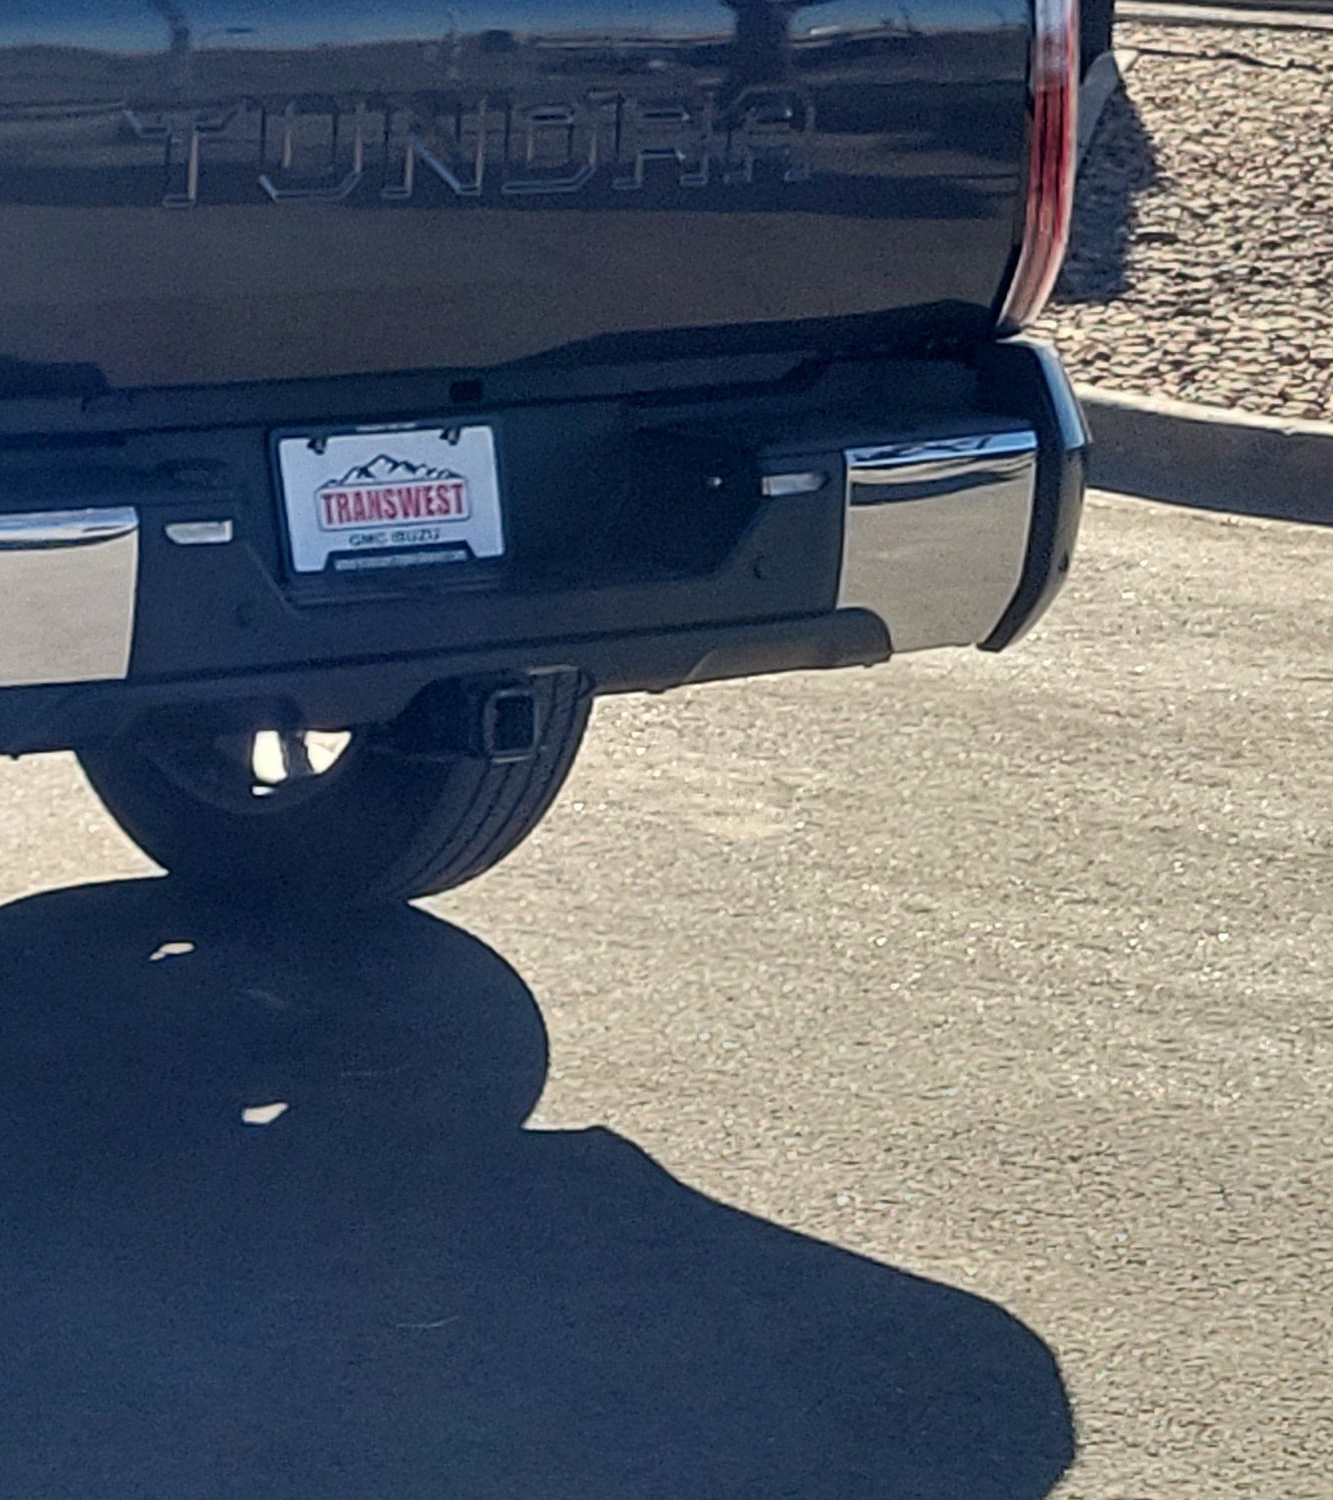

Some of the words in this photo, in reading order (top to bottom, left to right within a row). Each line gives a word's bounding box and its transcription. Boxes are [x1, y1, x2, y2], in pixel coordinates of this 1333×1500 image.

[122, 90, 815, 206] TUNDRA
[320, 484, 464, 525] TRANSWEST
[349, 531, 387, 547] GMC
